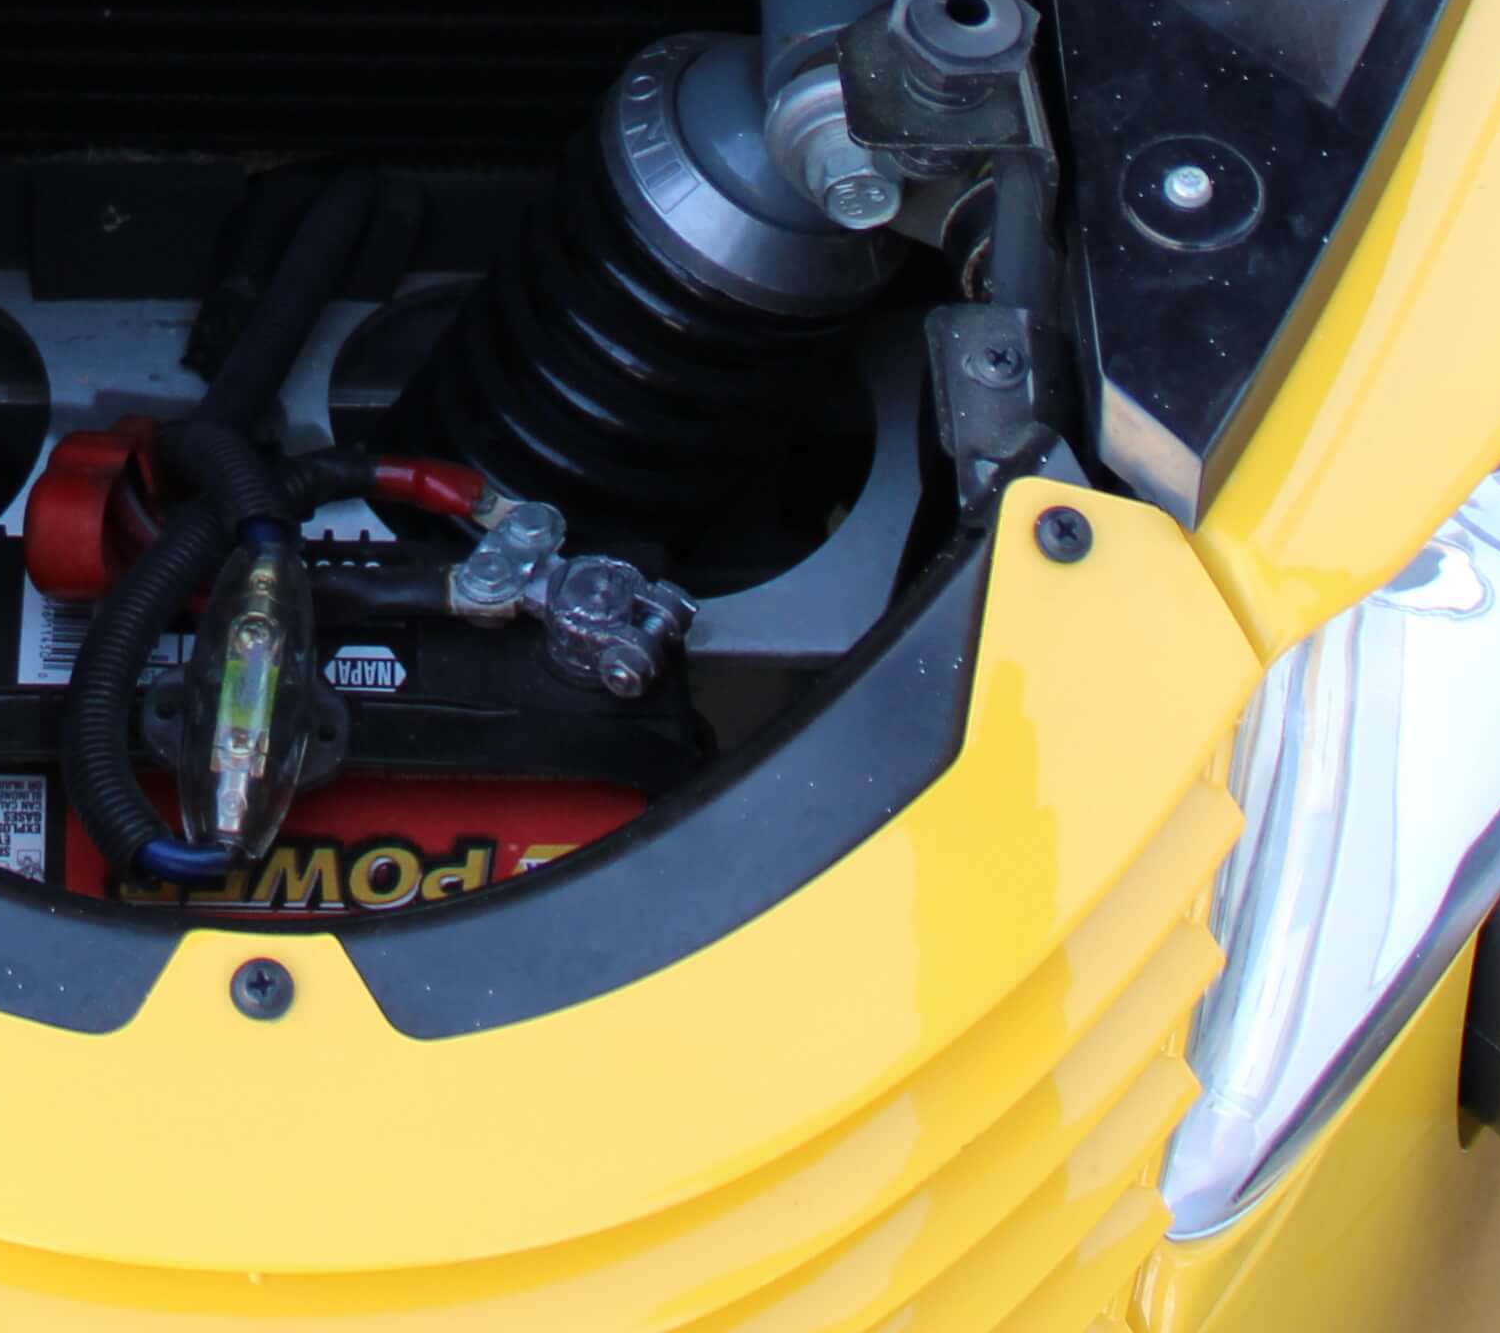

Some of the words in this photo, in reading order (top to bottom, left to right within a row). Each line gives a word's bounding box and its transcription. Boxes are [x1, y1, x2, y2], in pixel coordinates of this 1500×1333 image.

[335, 659, 394, 684] NAPA
[27, 780, 42, 790] OR
[19, 801, 42, 810] CAN
[3, 811, 42, 822] GASES
